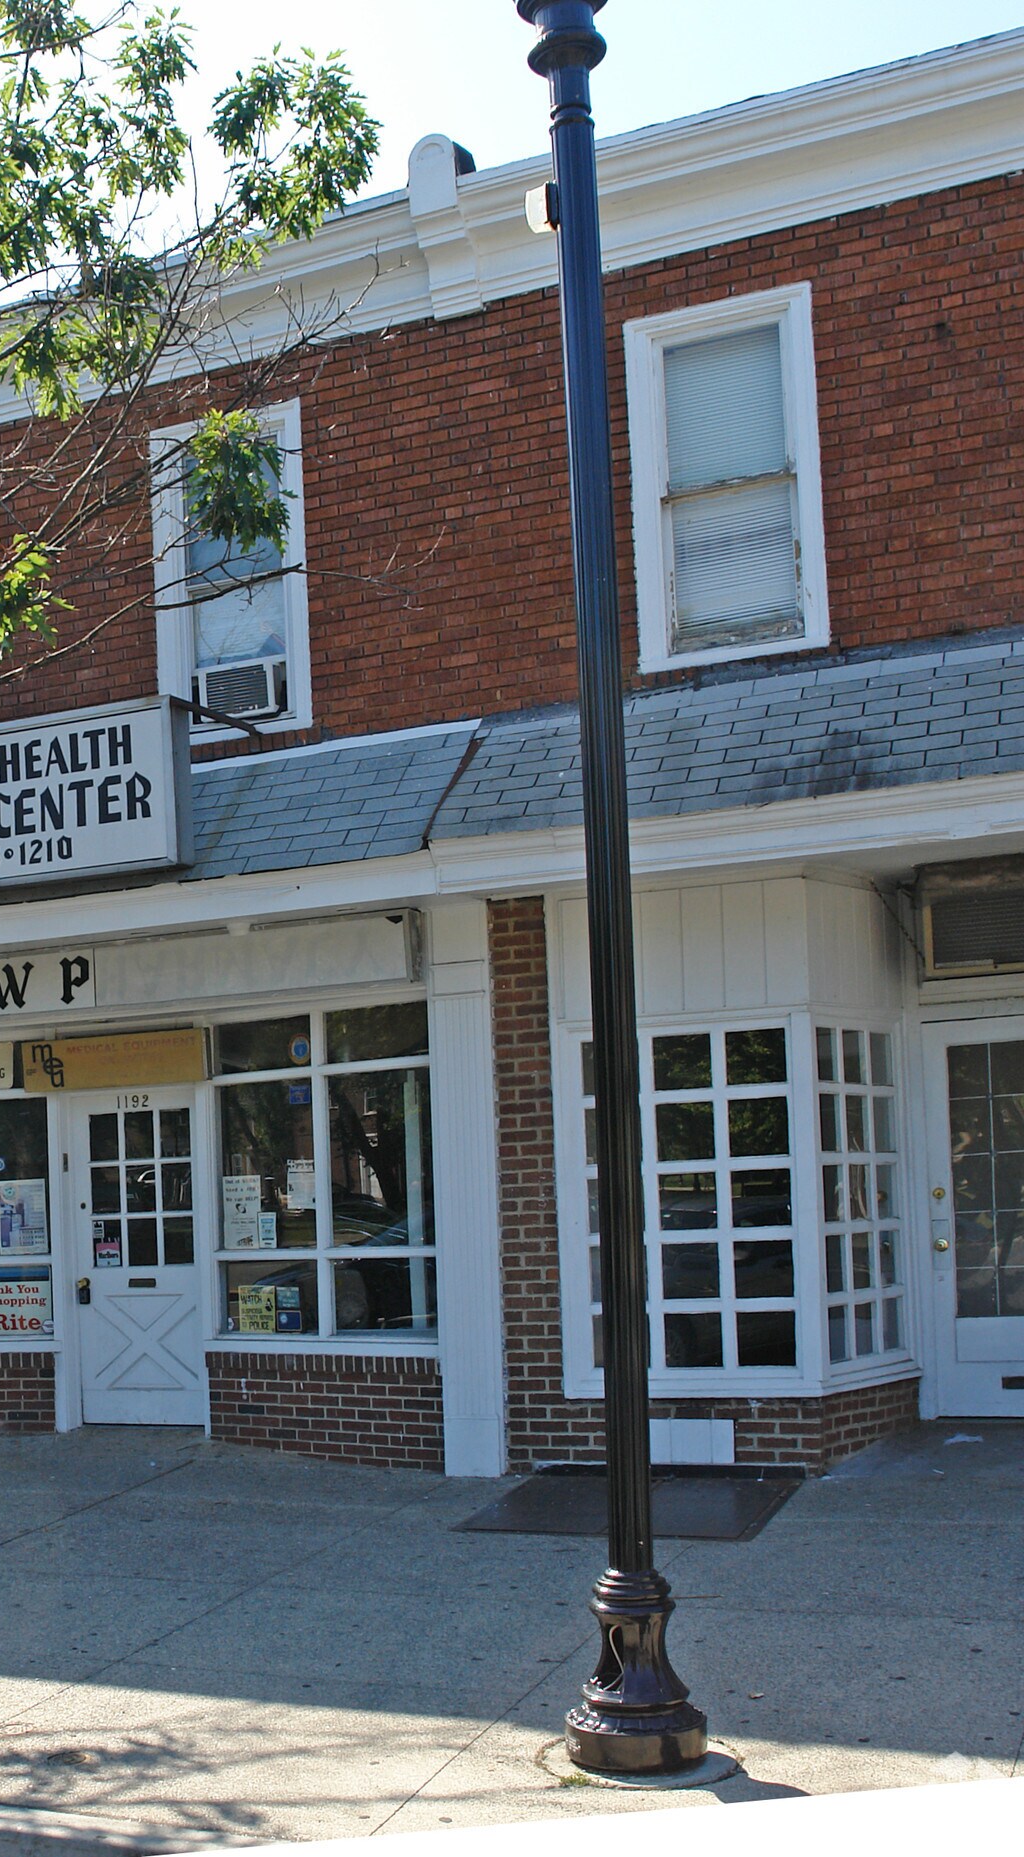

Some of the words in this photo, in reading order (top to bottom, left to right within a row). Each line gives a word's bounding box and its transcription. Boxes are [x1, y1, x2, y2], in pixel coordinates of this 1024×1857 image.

[59, 955, 90, 1005] P
[66, 1042, 118, 1055] MEDICAL
[123, 1034, 195, 1051] EQUIPMENT
[116, 1094, 150, 1109] 1192
[16, 1284, 40, 1294] You
[240, 1294, 263, 1305] WATCH
[248, 1320, 270, 1331] POLICE
